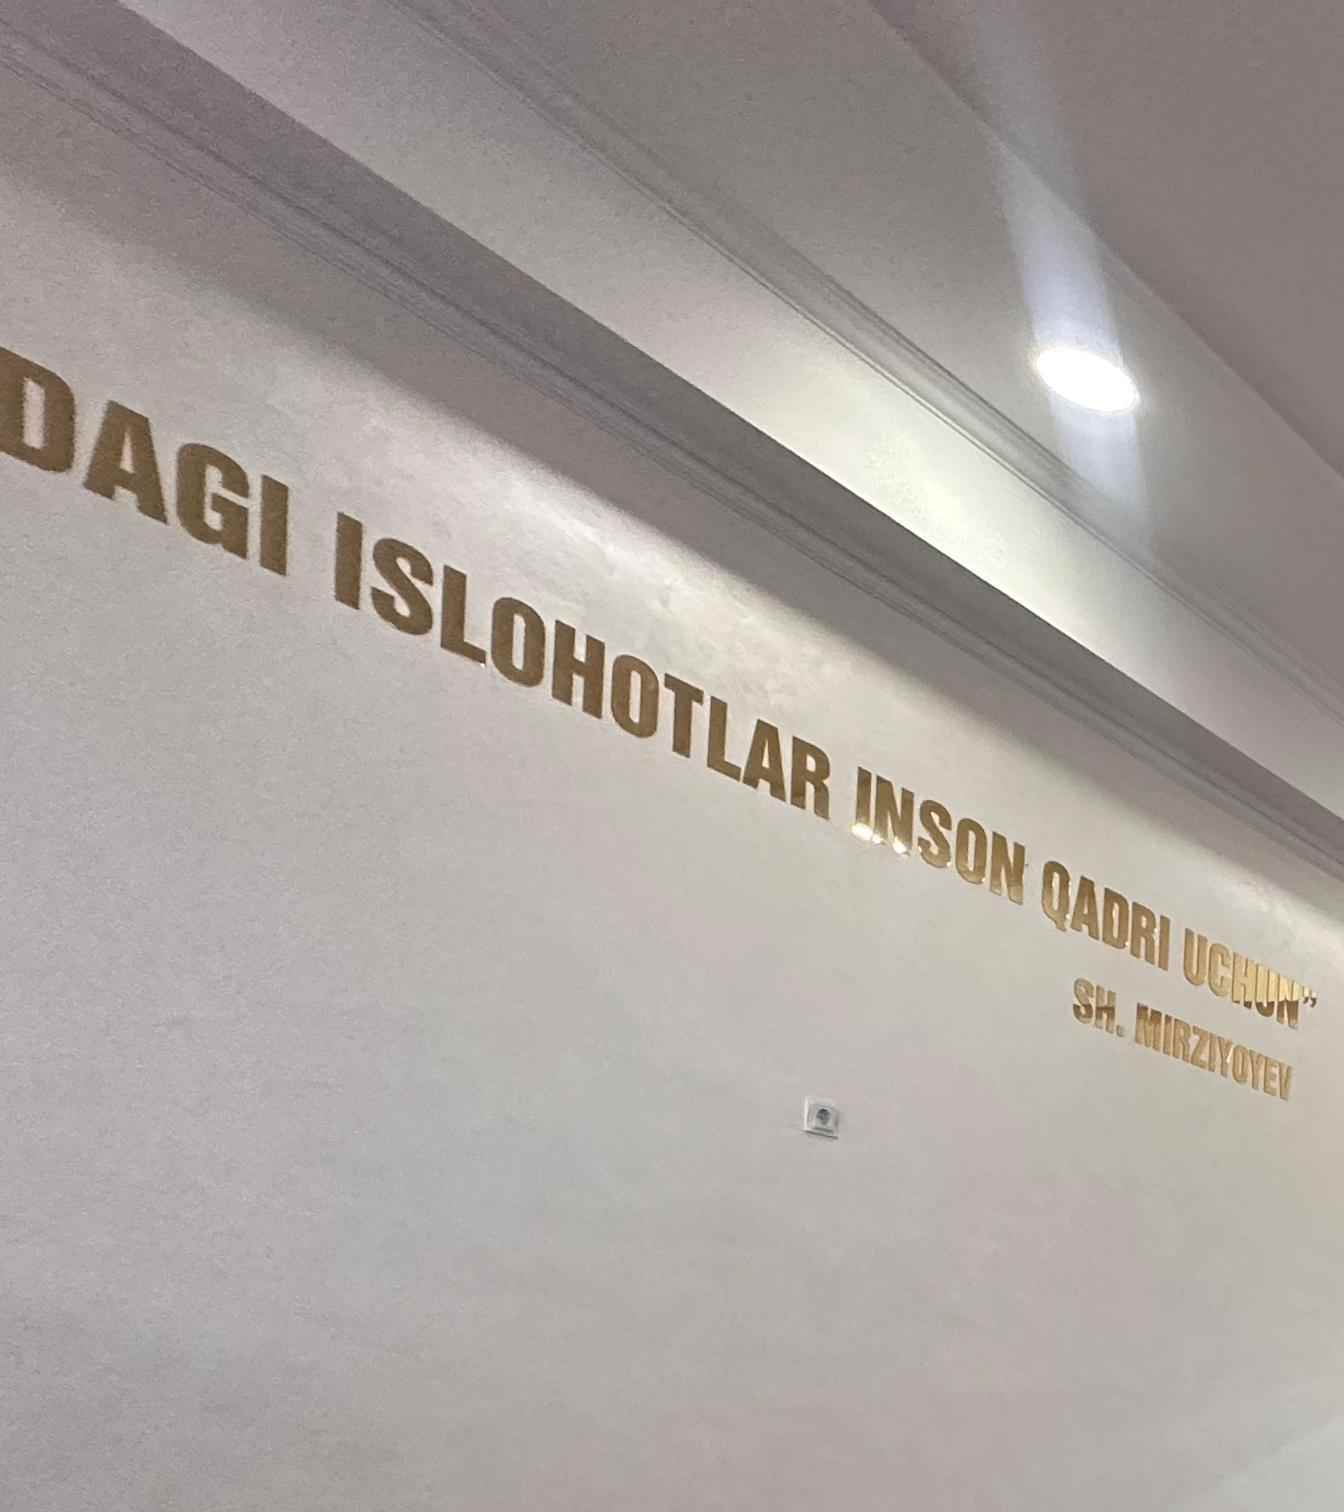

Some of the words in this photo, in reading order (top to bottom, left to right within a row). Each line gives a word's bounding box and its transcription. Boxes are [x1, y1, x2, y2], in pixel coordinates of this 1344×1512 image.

[0, 347, 289, 576] DAGI
[334, 512, 830, 820] ISLOHOTLAR
[855, 766, 1026, 905] INSON
[1041, 860, 1170, 971] QADRI
[1072, 977, 1124, 1037] SH.
[1135, 1003, 1293, 1101] MIRZIYOYEV
